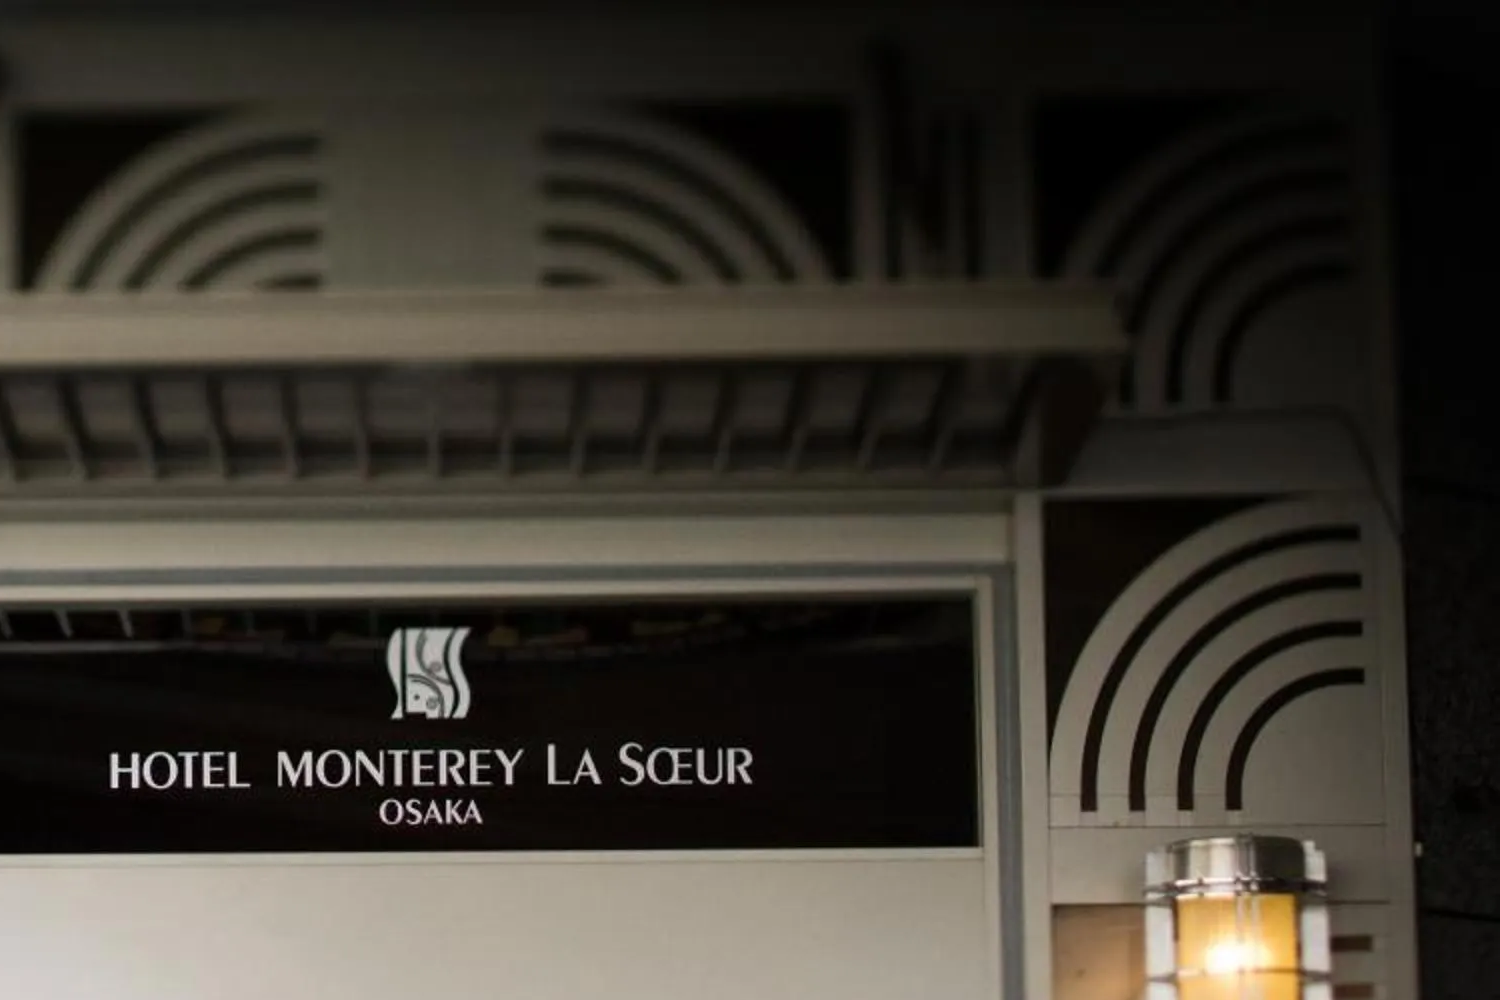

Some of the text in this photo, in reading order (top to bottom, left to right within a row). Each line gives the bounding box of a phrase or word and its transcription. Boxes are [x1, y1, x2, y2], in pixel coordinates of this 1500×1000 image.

[108, 750, 252, 790] HOTEL
[276, 748, 525, 789] MONTEREY
[546, 743, 603, 786] LA
[378, 798, 484, 826] OSAKA
